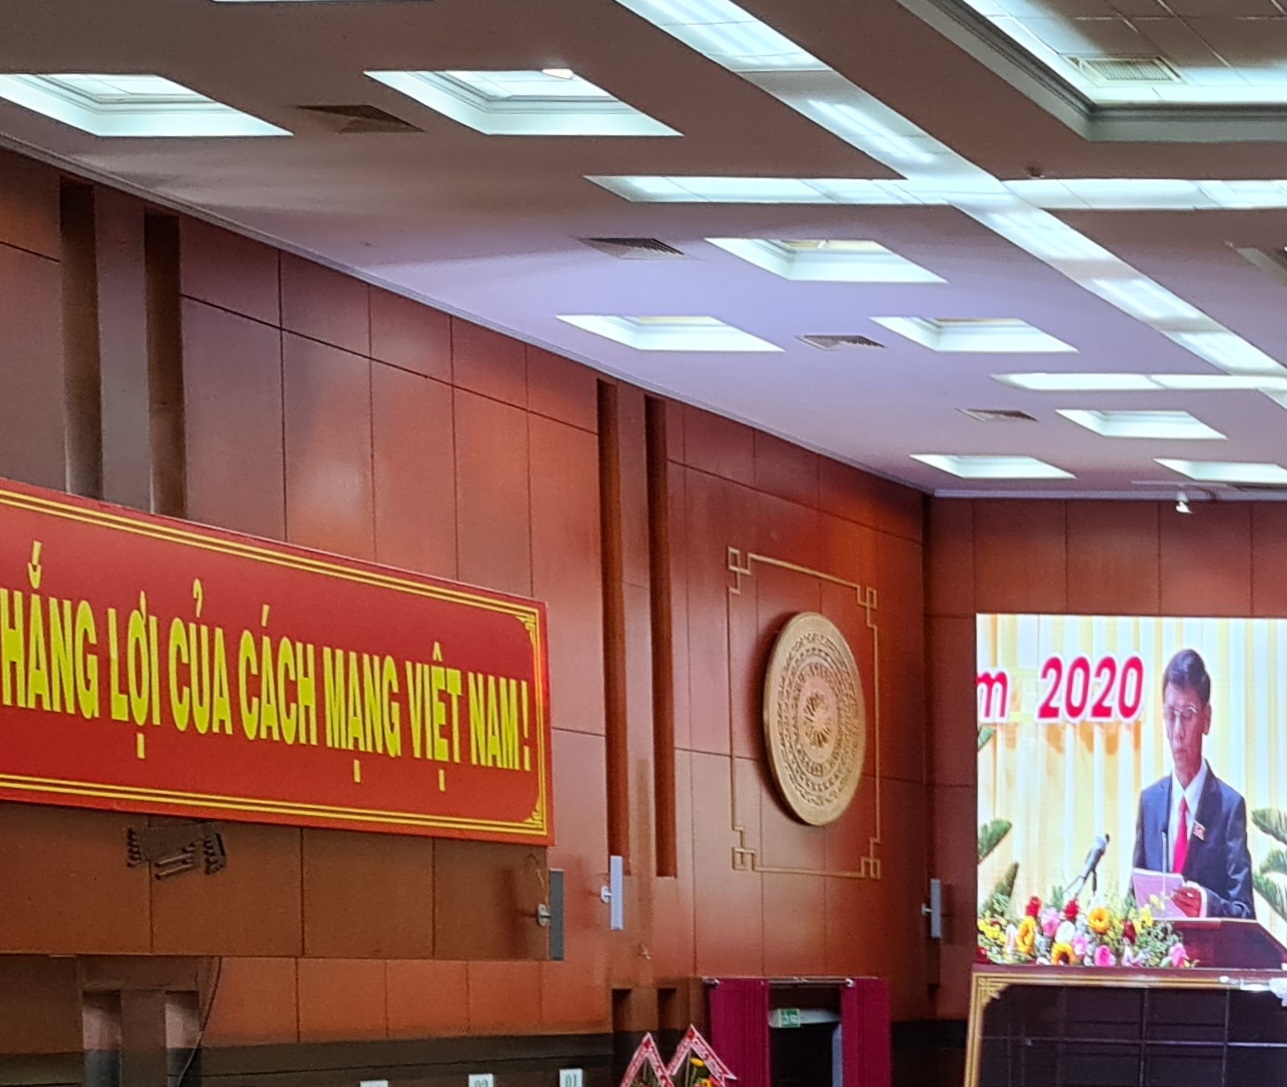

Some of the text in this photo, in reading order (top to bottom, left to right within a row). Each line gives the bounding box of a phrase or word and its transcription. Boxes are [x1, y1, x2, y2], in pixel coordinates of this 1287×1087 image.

[108, 590, 161, 759] LỢI
[169, 578, 233, 734] CỦA
[239, 604, 317, 746] CÁCH
[323, 646, 401, 783] MẠNG
[405, 641, 463, 792] VIỆT
[1038, 656, 1144, 719] 2020
